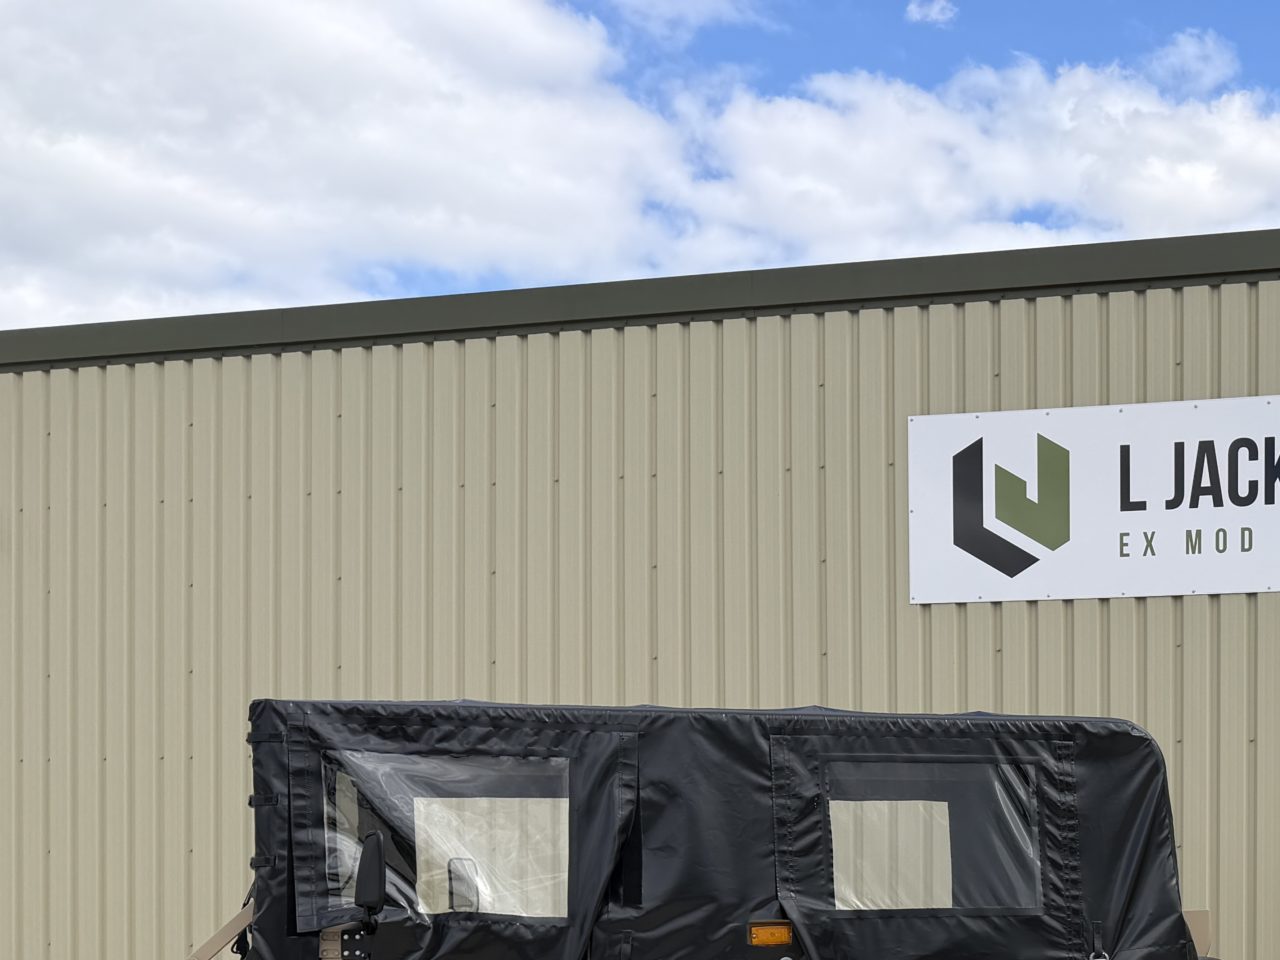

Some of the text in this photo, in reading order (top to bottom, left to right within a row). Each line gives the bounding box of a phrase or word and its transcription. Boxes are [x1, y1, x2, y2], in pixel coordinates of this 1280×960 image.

[1119, 444, 1148, 513] L
[1119, 530, 1156, 558] EX
[1185, 526, 1253, 555] MOD
